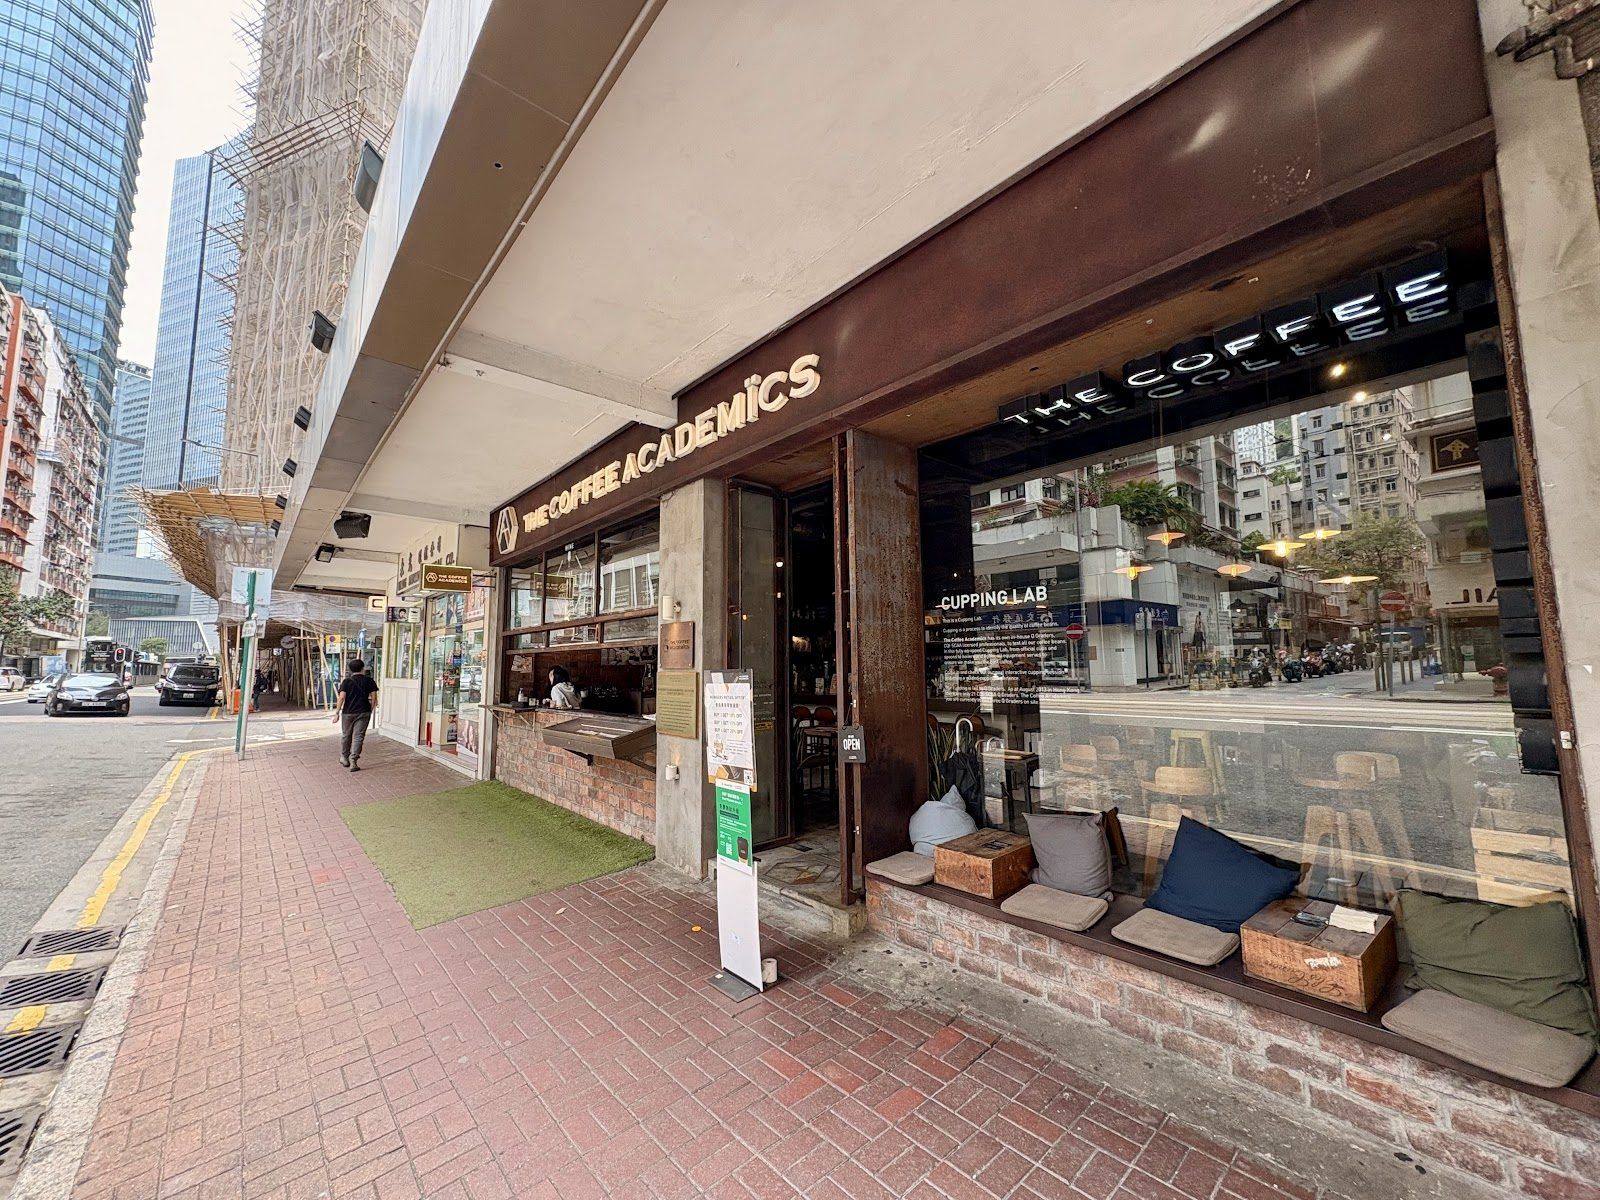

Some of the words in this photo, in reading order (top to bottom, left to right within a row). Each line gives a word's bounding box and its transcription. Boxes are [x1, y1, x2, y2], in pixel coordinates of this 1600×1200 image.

[1003, 388, 1108, 424] THE
[1127, 271, 1449, 387] COFFEE
[523, 504, 550, 532] THE
[549, 461, 621, 519] COFFEE
[941, 590, 1008, 611] CUPPING
[1013, 586, 1048, 604] LAB
[843, 738, 860, 750] OPEN
